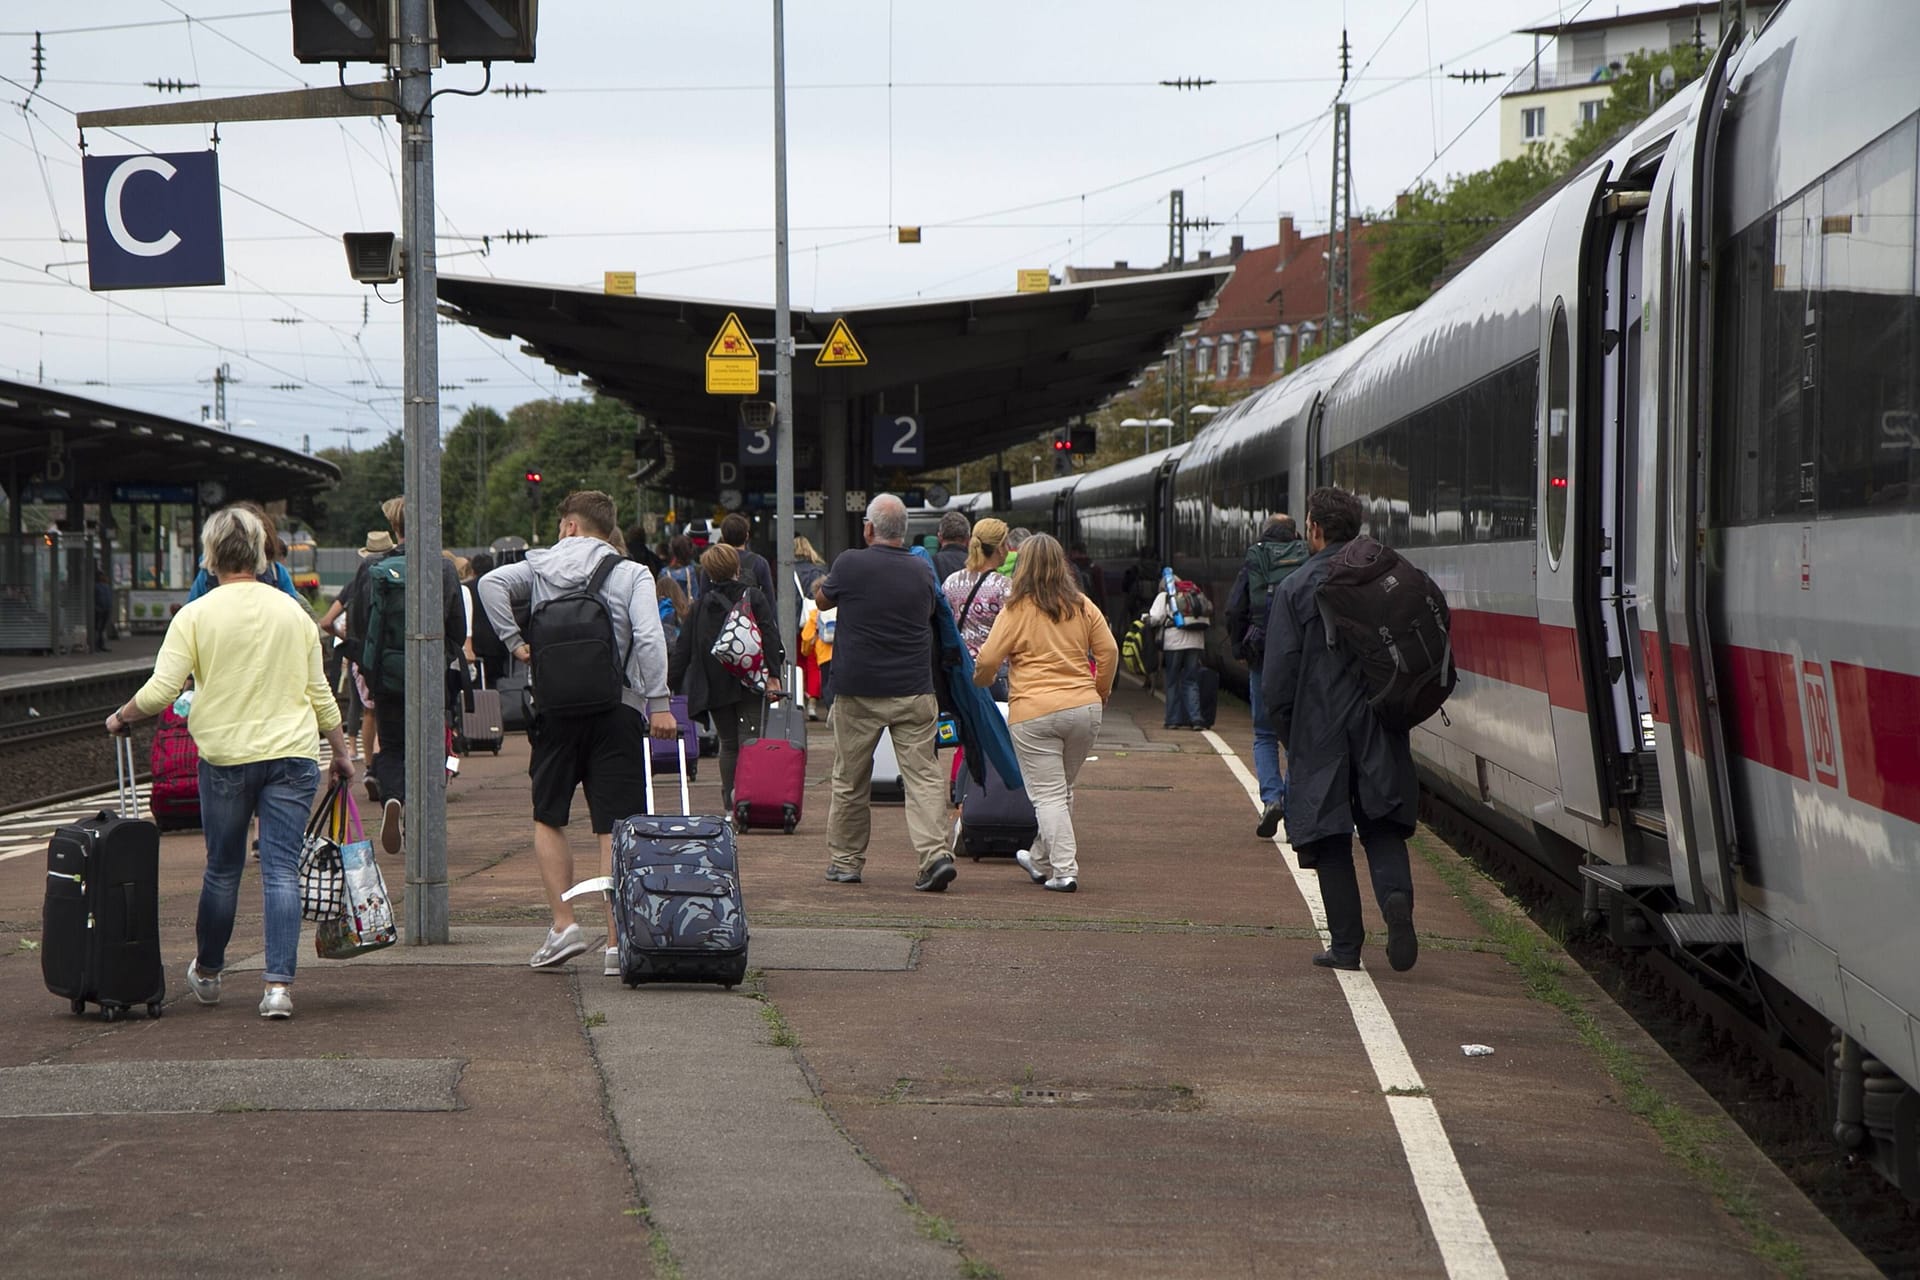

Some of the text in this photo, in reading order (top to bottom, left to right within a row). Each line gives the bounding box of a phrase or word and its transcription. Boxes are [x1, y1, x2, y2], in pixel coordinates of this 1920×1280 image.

[104, 156, 182, 257] C
[746, 429, 771, 455] 3
[892, 417, 917, 454] 2
[46, 460, 64, 481] D
[720, 462, 737, 484] D
[1805, 681, 1833, 767] DB
